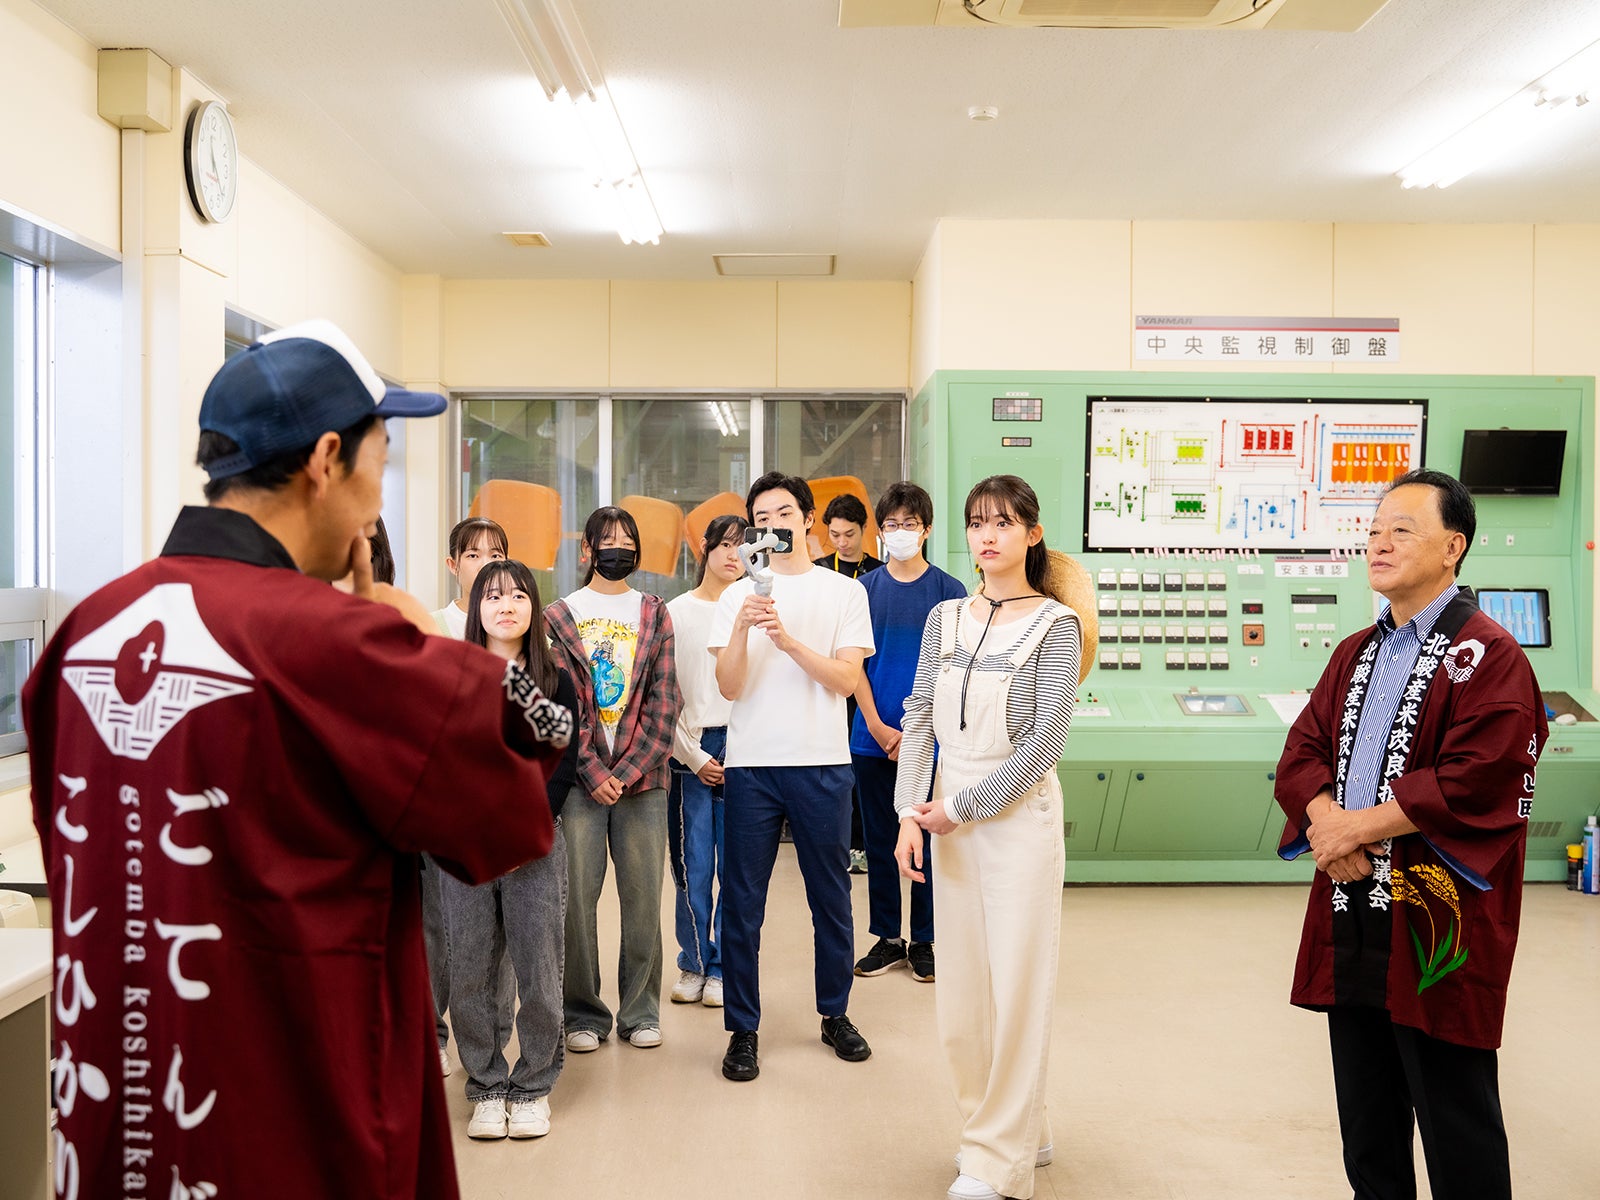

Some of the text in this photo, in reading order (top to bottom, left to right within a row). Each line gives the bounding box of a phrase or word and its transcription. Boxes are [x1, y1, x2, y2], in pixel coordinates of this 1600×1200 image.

[1141, 316, 1193, 325] YANMAR
[1147, 335, 1388, 357] 中央監視制御盤
[1281, 564, 1342, 575] 安全確認
[119, 784, 154, 1200] gotemba koshihika
